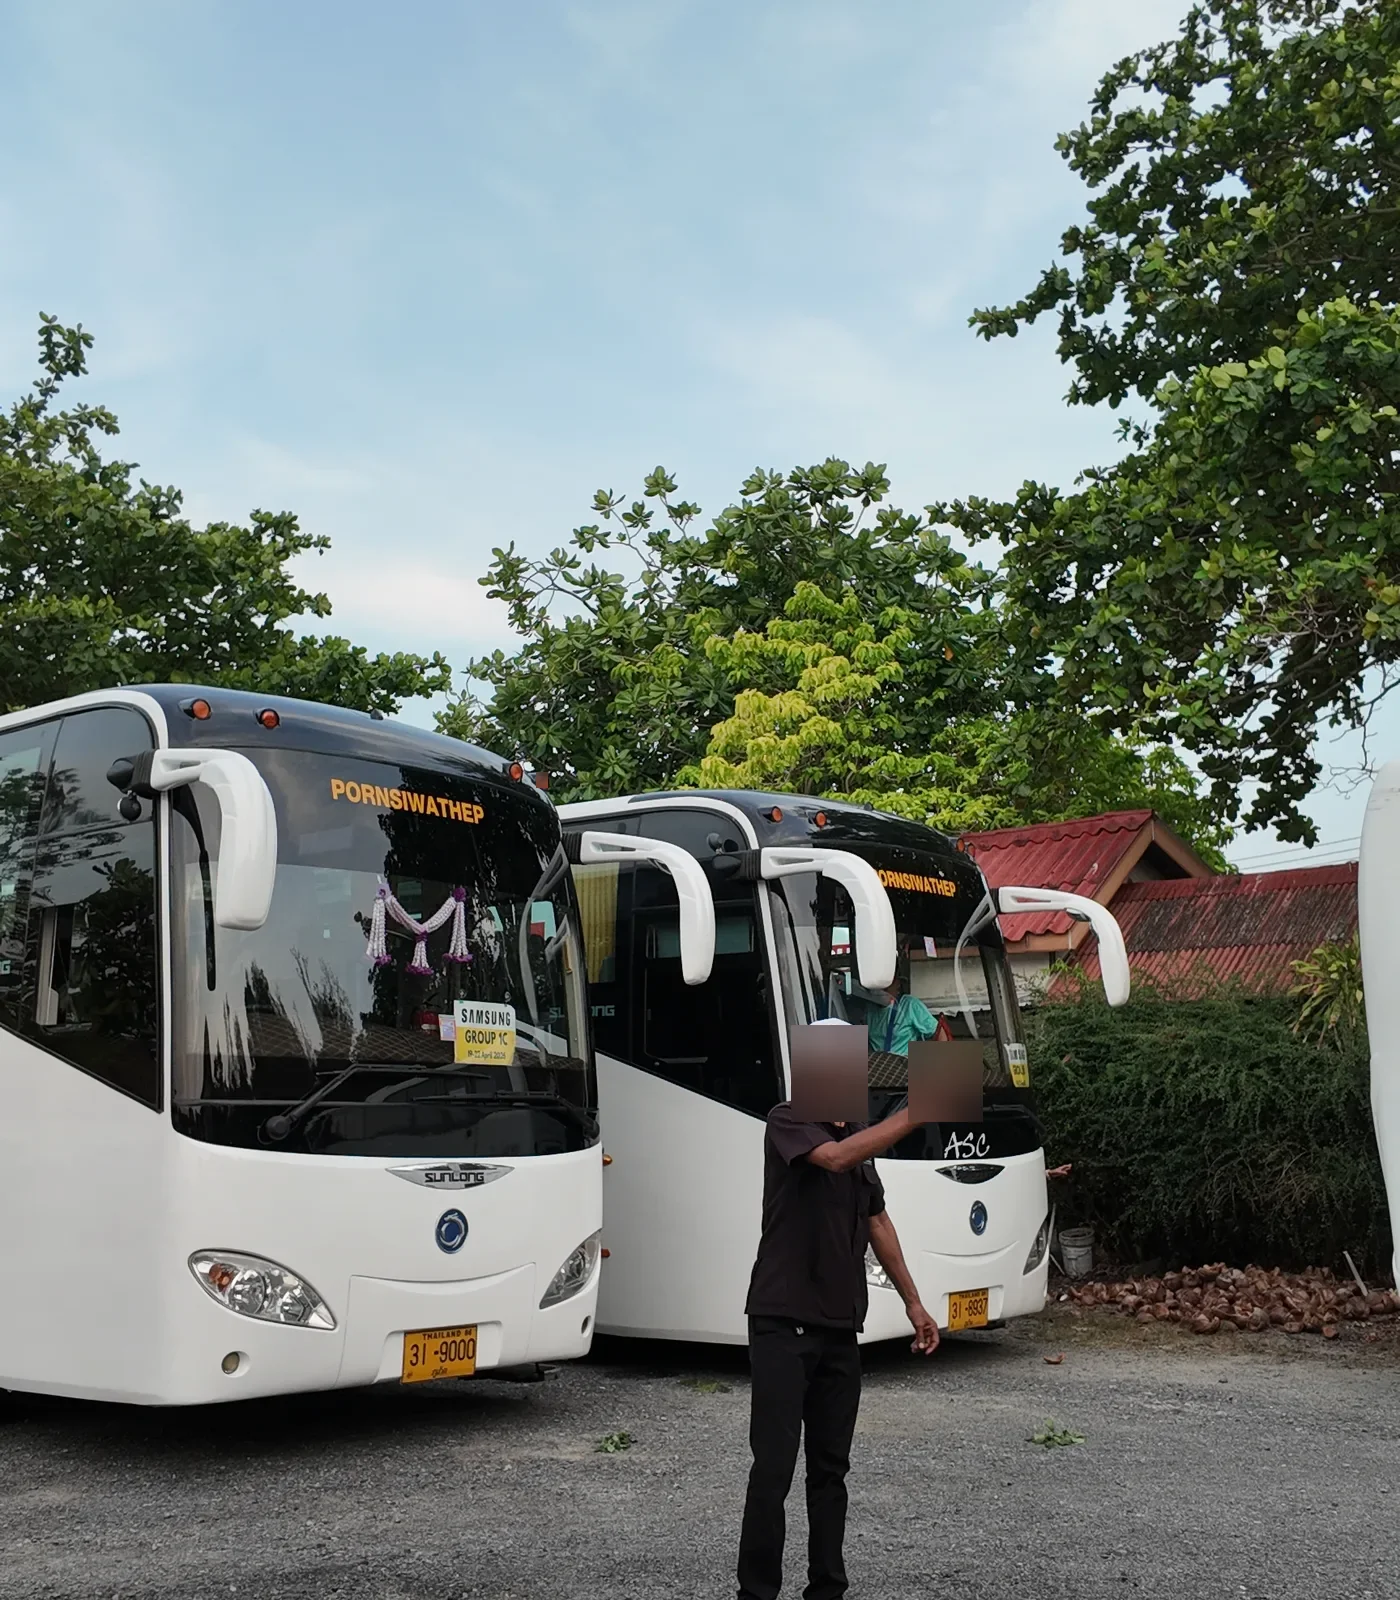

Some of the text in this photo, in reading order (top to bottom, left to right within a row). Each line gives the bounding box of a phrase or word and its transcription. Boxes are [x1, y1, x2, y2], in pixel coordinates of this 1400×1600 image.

[330, 778, 485, 825] PORNSIWATHEP
[876, 869, 956, 897] ORNSIWATHEP
[461, 1008, 511, 1027] SAMSUNG
[464, 1029, 496, 1045] GROUP
[943, 1131, 990, 1159] ASC
[424, 1172, 485, 1183] SUNLONG
[422, 1330, 462, 1341] THAILAND
